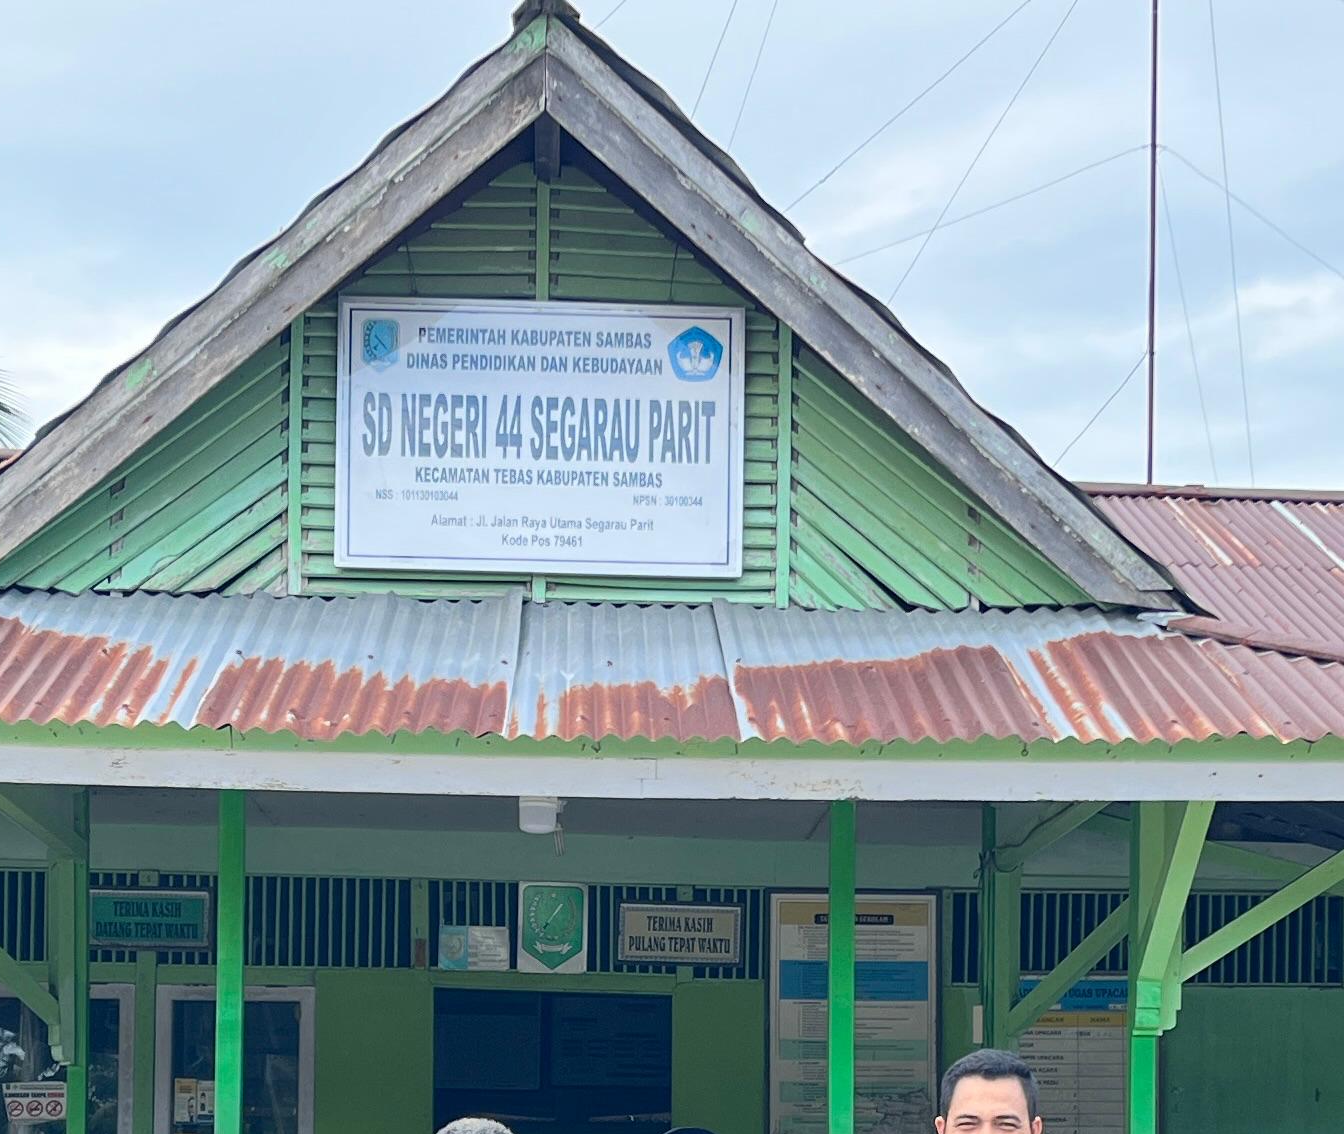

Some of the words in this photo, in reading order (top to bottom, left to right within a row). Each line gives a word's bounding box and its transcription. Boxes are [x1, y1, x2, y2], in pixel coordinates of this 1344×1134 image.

[418, 327, 506, 346] PEMERINTAH
[511, 328, 592, 348] KABUPATEN
[596, 331, 652, 349] SAMBAS
[406, 352, 448, 370] DINAS
[452, 354, 536, 373] PENDIDIKAN
[540, 356, 569, 374] DAN
[572, 357, 663, 376] KEBUDAYAAN
[362, 391, 392, 458] SD
[401, 392, 488, 459] NEGERI
[496, 394, 522, 460] 44
[530, 396, 640, 463] SEGARAU
[648, 400, 716, 465] PARIT
[415, 466, 490, 484] KECAMATAN
[494, 468, 533, 485] TEBAS
[536, 470, 609, 487] KABUPATEN
[613, 472, 662, 488] SAMBAS
[375, 489, 394, 500] NSS
[632, 496, 656, 506] NPSN
[431, 514, 466, 527] Alamat
[490, 516, 518, 528] Jalan
[522, 516, 546, 531] Raya
[550, 517, 582, 530] Utama
[585, 518, 626, 532] Segarau
[630, 518, 654, 531] Parit
[502, 534, 528, 546] Kode
[532, 535, 550, 547] Pos
[554, 536, 582, 548] 79461
[646, 916, 682, 932] TERIMA
[684, 917, 713, 933] KASIH
[628, 936, 666, 952] PULANG
[668, 937, 696, 953] TEPAT
[698, 938, 730, 954] WAKTU
